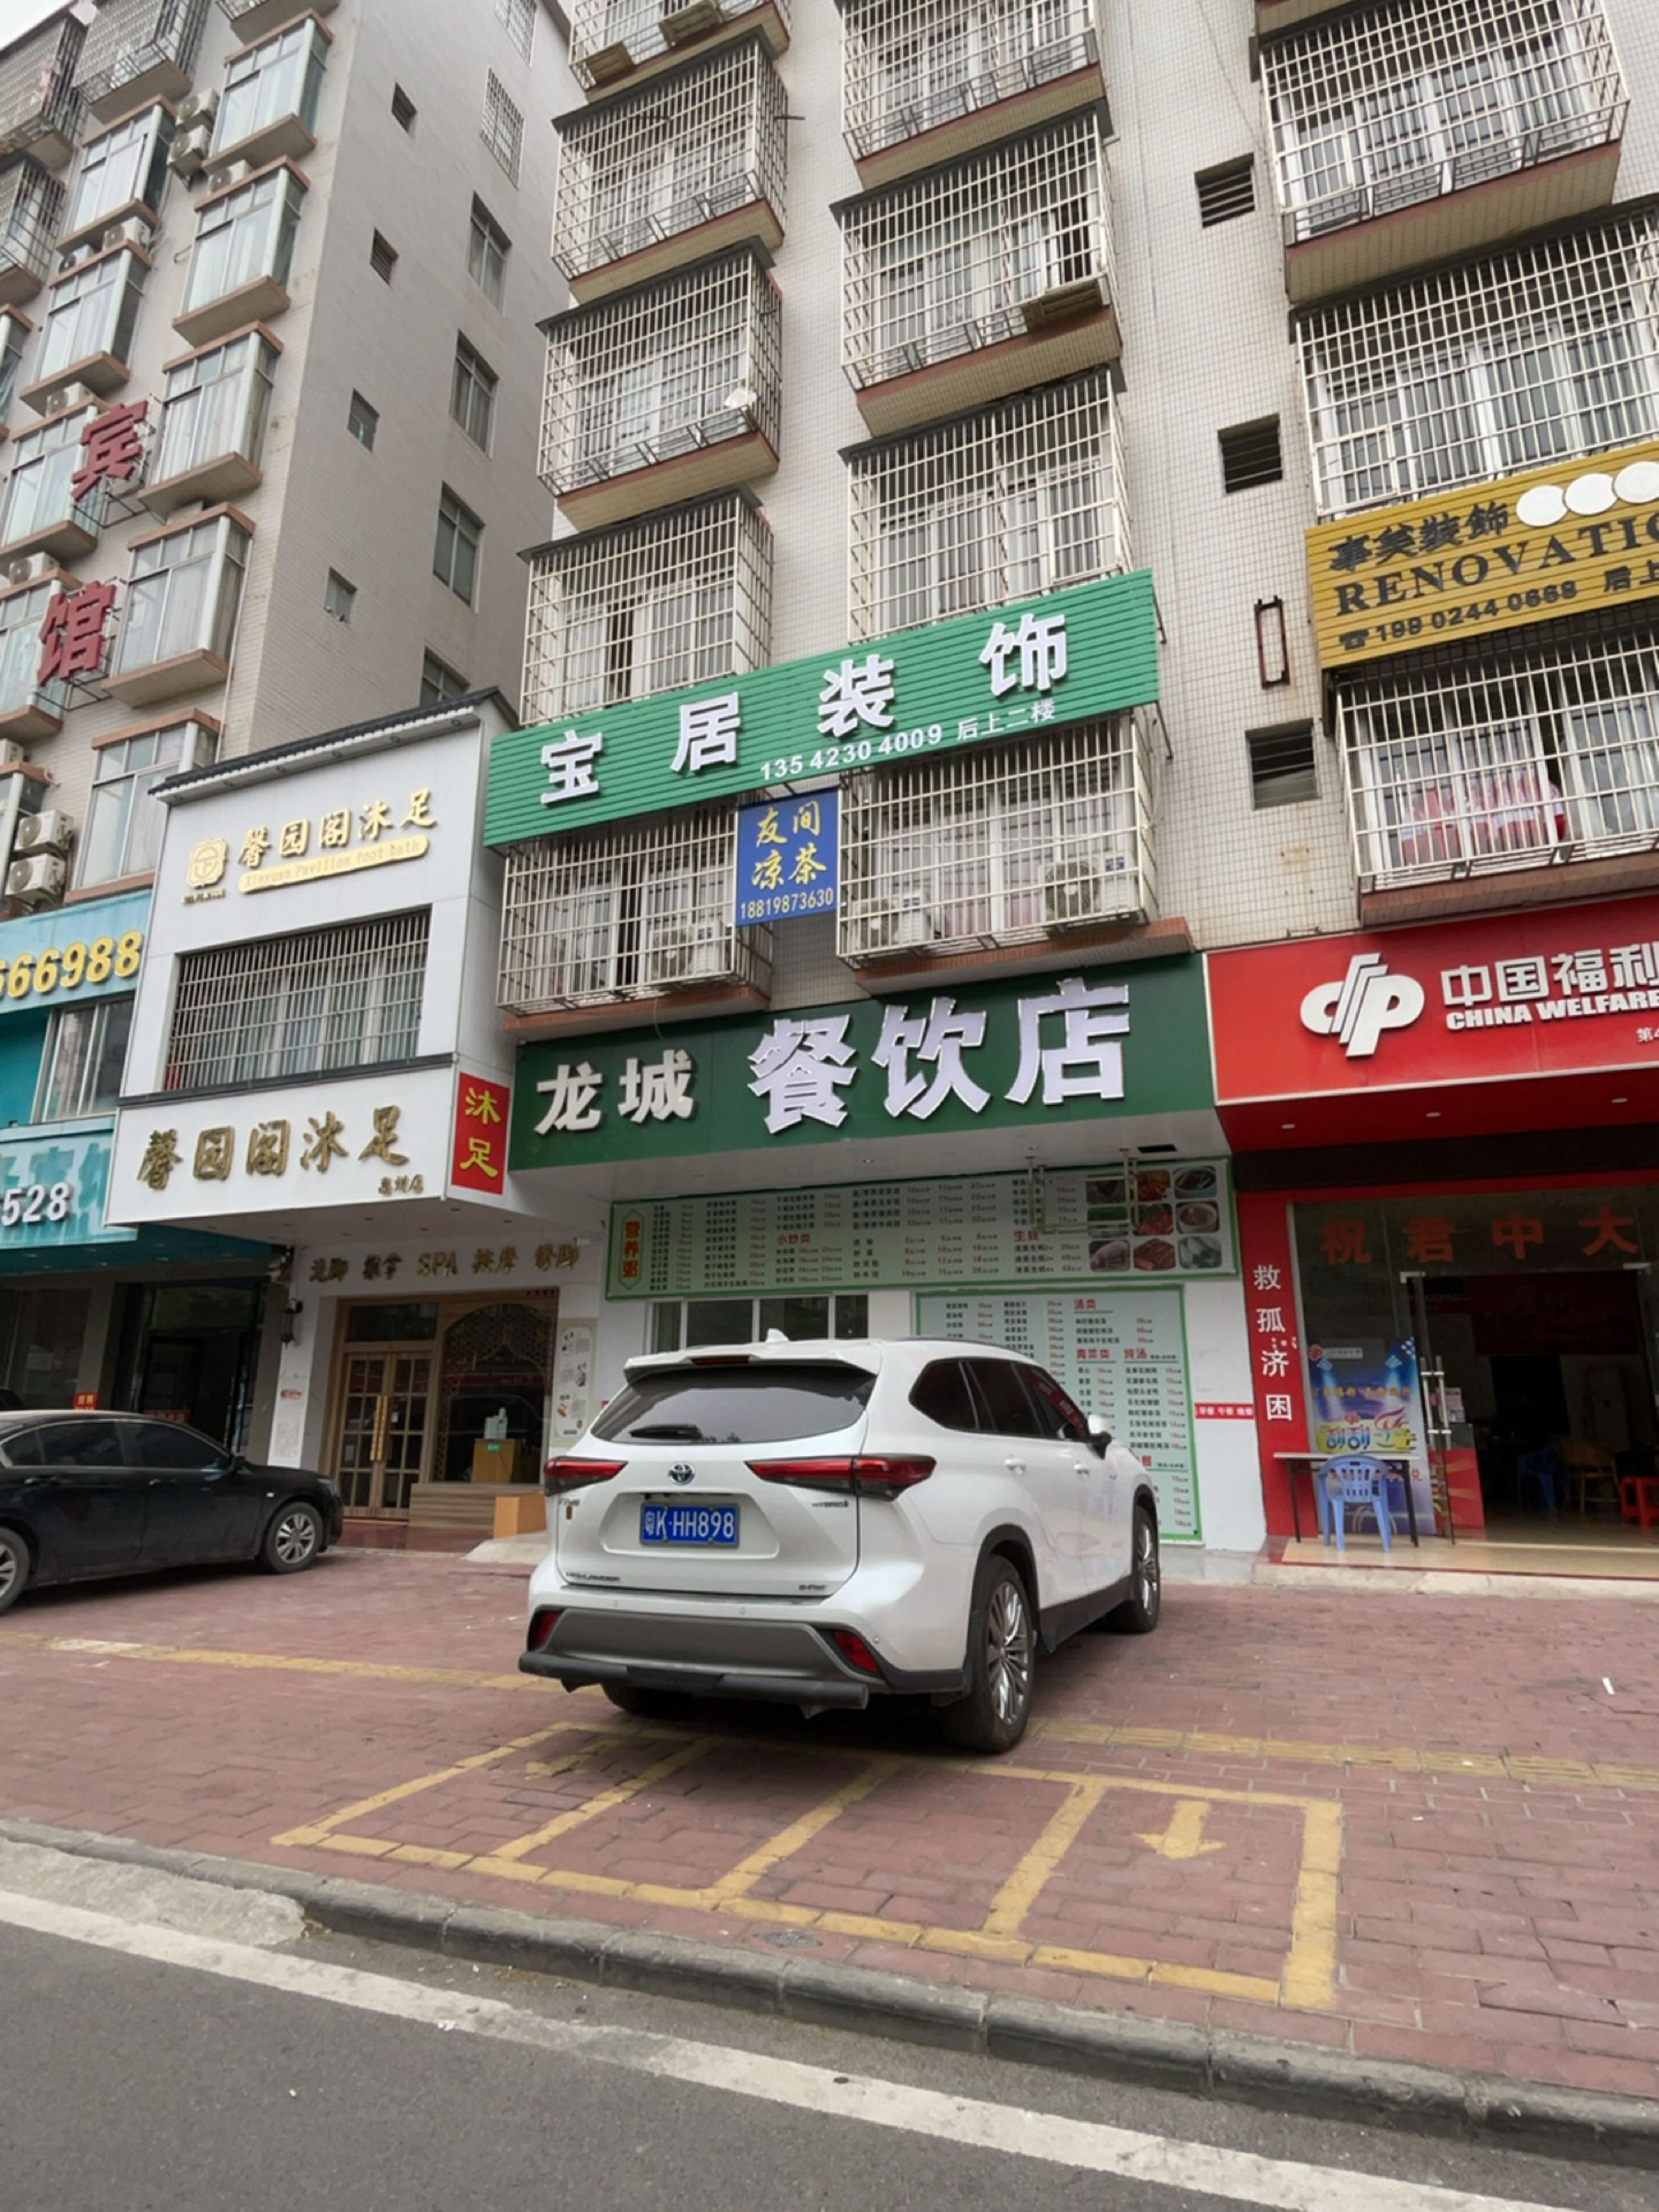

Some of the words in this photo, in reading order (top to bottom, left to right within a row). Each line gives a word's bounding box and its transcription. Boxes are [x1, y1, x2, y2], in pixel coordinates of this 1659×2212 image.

[36, 398, 148, 686] 宾馆
[1375, 618, 1422, 641] 199
[1431, 599, 1500, 629] 0244
[540, 613, 1068, 805] 宝居装饰
[760, 755, 803, 780] 135
[810, 741, 871, 769] 4230
[879, 724, 942, 755] 4009
[957, 699, 1056, 741] 后上二楼
[756, 801, 821, 847] 友间
[741, 888, 834, 920] 18819873630
[1441, 941, 1659, 1006] 中国福利
[1447, 1004, 1532, 1030] CHINA
[1536, 989, 1659, 1021] WELFARE
[533, 1049, 695, 1135] 龙城
[748, 977, 1131, 1134] 餐饮店
[460, 1087, 502, 1178] 沐足
[416, 1251, 458, 1277] SPA
[1318, 1205, 1639, 1266] 祝君中大
[1254, 1264, 1292, 1421] 救孤济困
